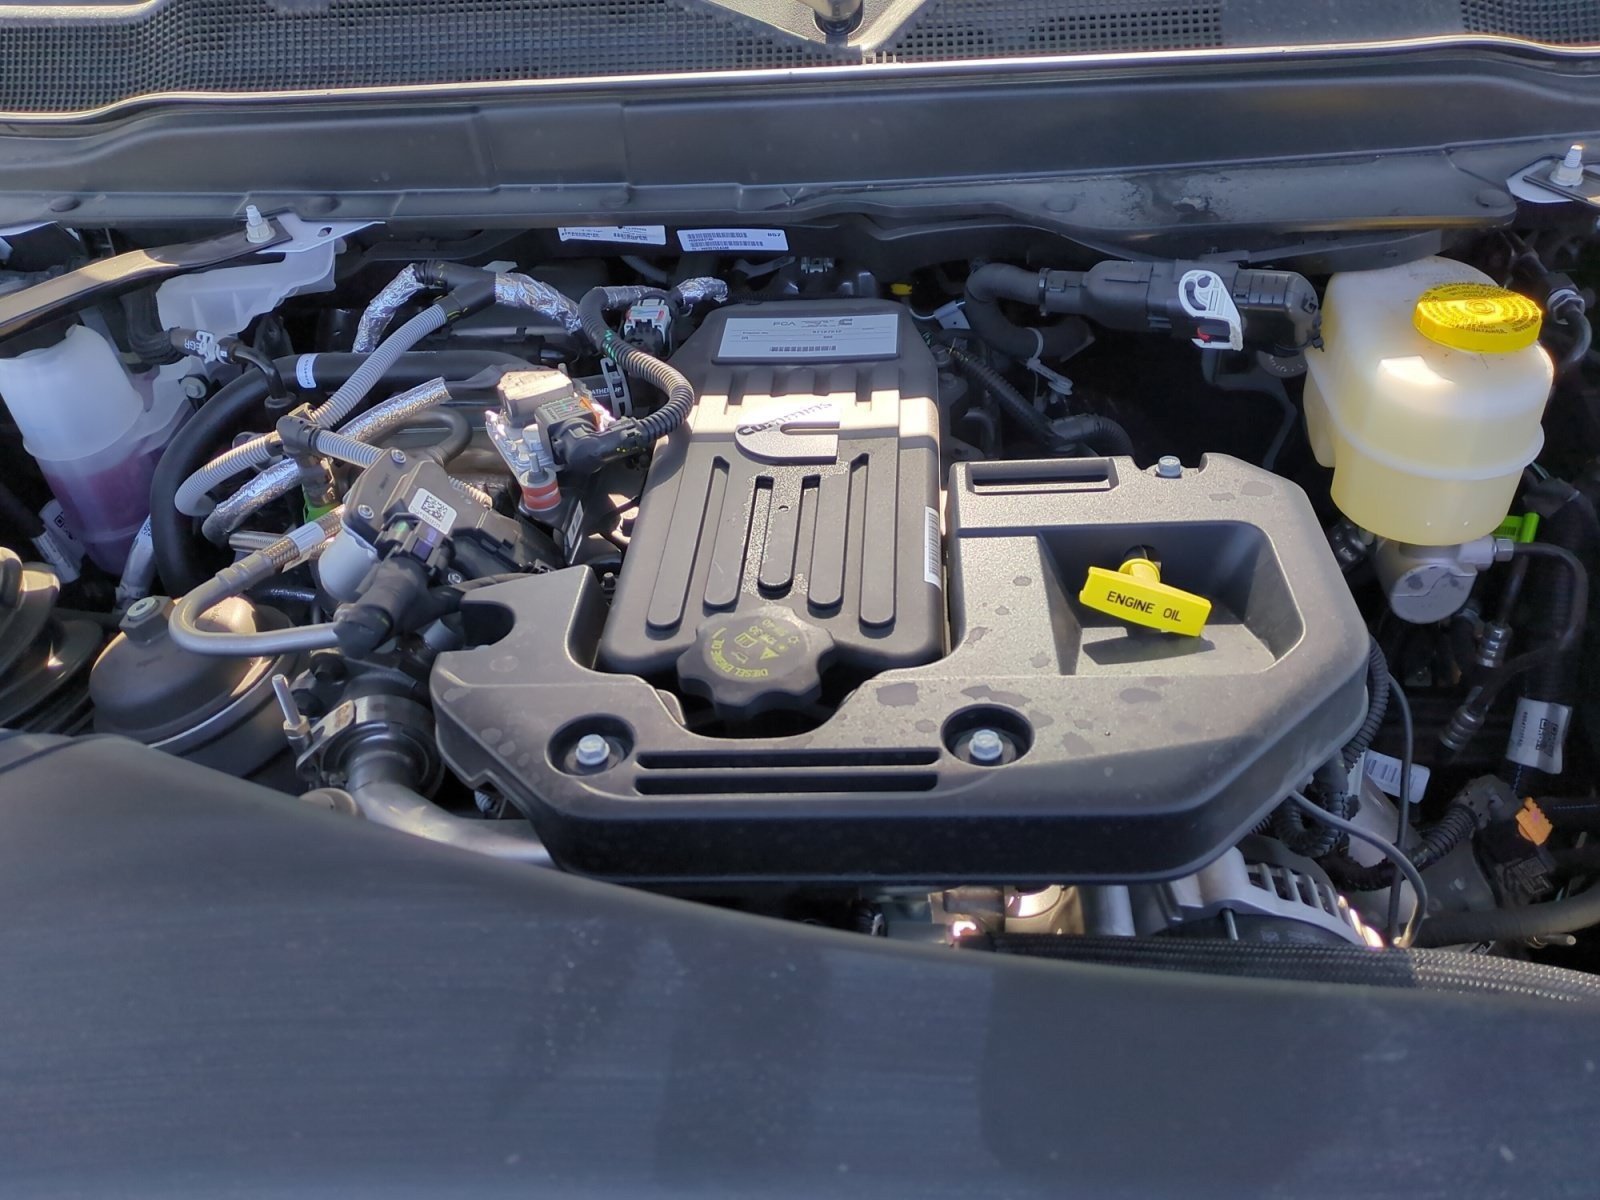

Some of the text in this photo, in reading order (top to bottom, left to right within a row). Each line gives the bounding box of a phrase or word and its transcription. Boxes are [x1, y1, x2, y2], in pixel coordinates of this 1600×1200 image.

[1106, 590, 1181, 622] ENGINE OIL
[735, 667, 768, 677] DIESEL
